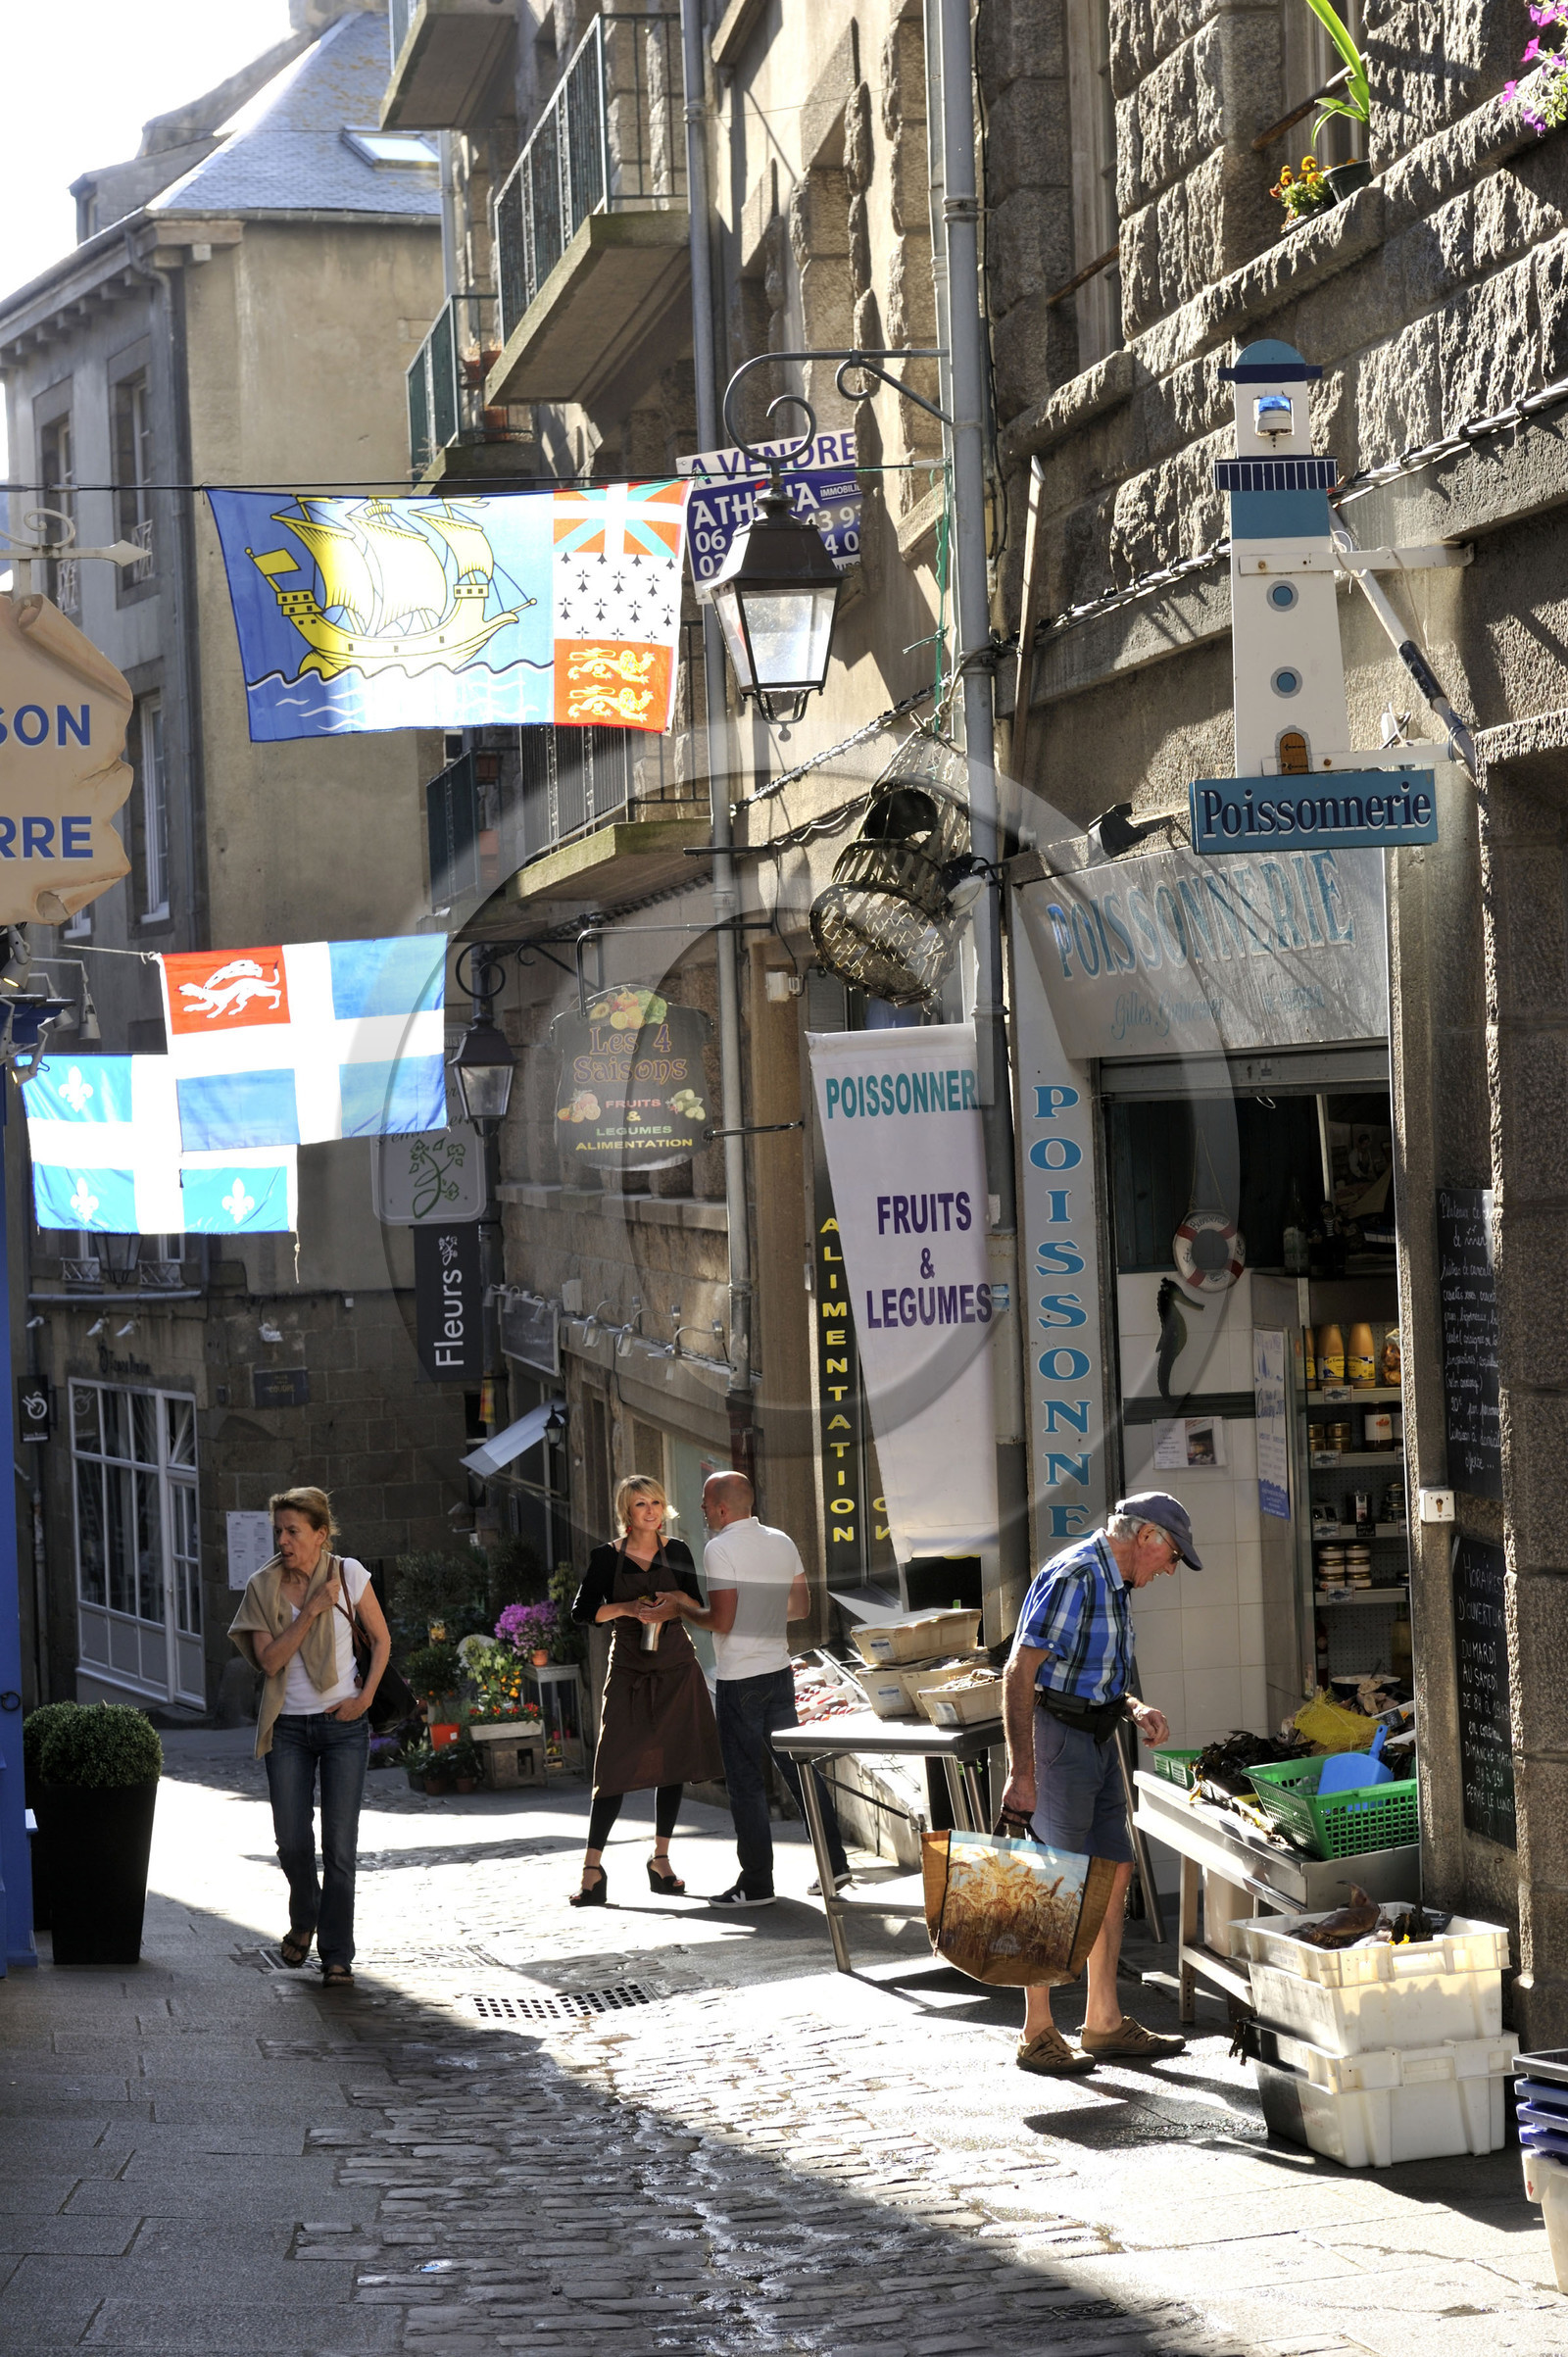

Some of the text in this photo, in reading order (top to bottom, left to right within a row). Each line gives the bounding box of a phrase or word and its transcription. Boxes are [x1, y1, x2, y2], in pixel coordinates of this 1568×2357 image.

[695, 529, 726, 553] 06
[1200, 781, 1432, 838] Poissonnerie
[1046, 850, 1356, 979] POISSONNERIE
[590, 1024, 672, 1056] Les 4
[573, 1056, 688, 1085] Saisons
[605, 1099, 662, 1108] FRUITS
[626, 1110, 642, 1122] &
[575, 1139, 693, 1151] ALIMENTATION
[596, 1125, 673, 1137] LEGUMES
[877, 1191, 972, 1235] FRUITS
[919, 1247, 935, 1280] &
[433, 1268, 465, 1367] Fleurs
[866, 1283, 993, 1329] LEGUMES
[1028, 1084, 1095, 1539] POISSONNE
[820, 1217, 856, 1544] ALIMENTATION
[1458, 1594, 1504, 1629] D'OUVERTUR
